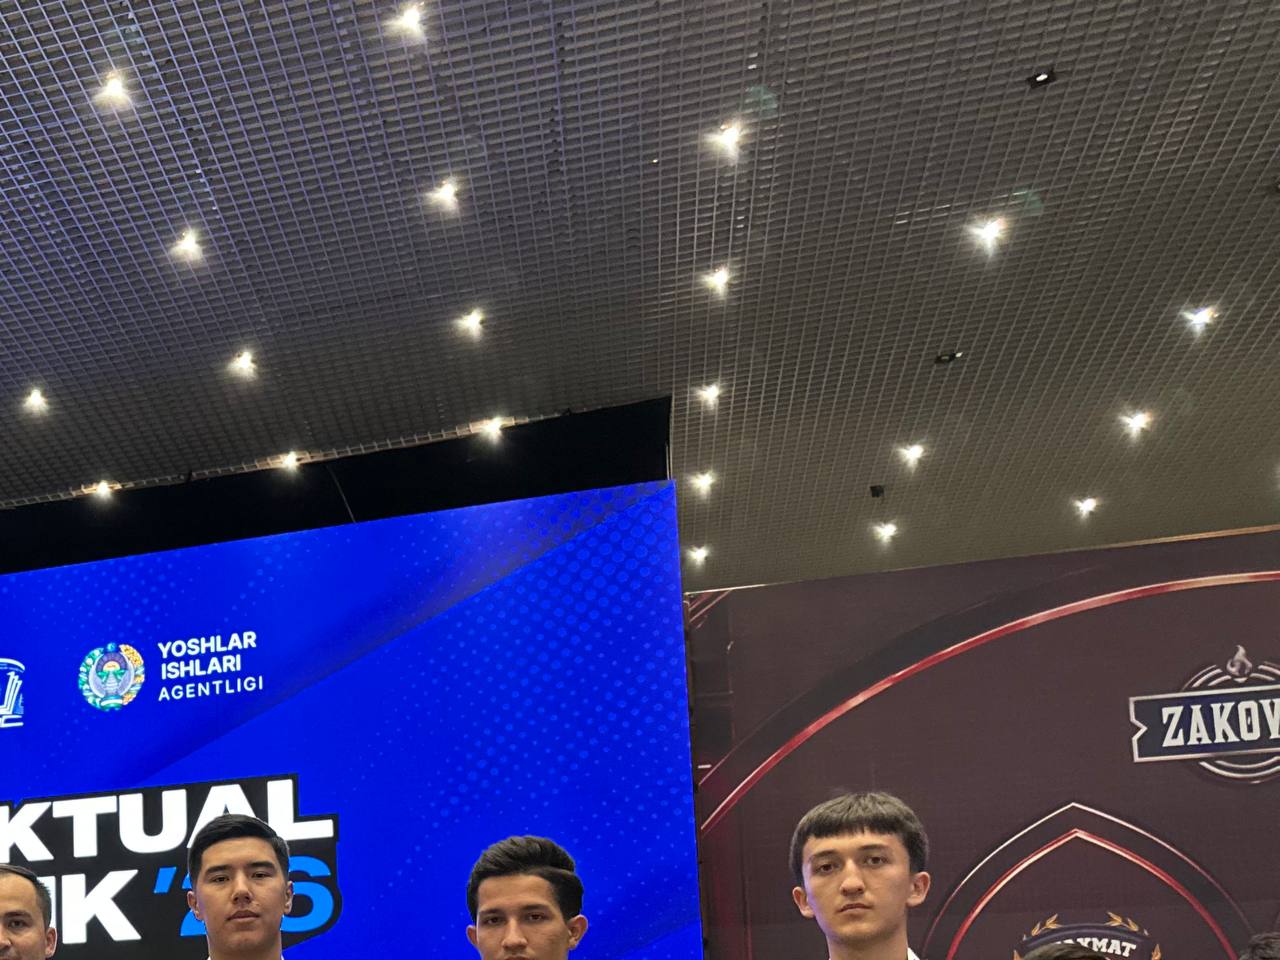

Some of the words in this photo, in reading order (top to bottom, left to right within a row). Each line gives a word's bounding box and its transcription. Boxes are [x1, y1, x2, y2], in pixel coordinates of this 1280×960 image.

[158, 631, 257, 658] YOSHLAR
[161, 654, 241, 680] ISHLARI
[158, 676, 263, 701] AGENTLIGI
